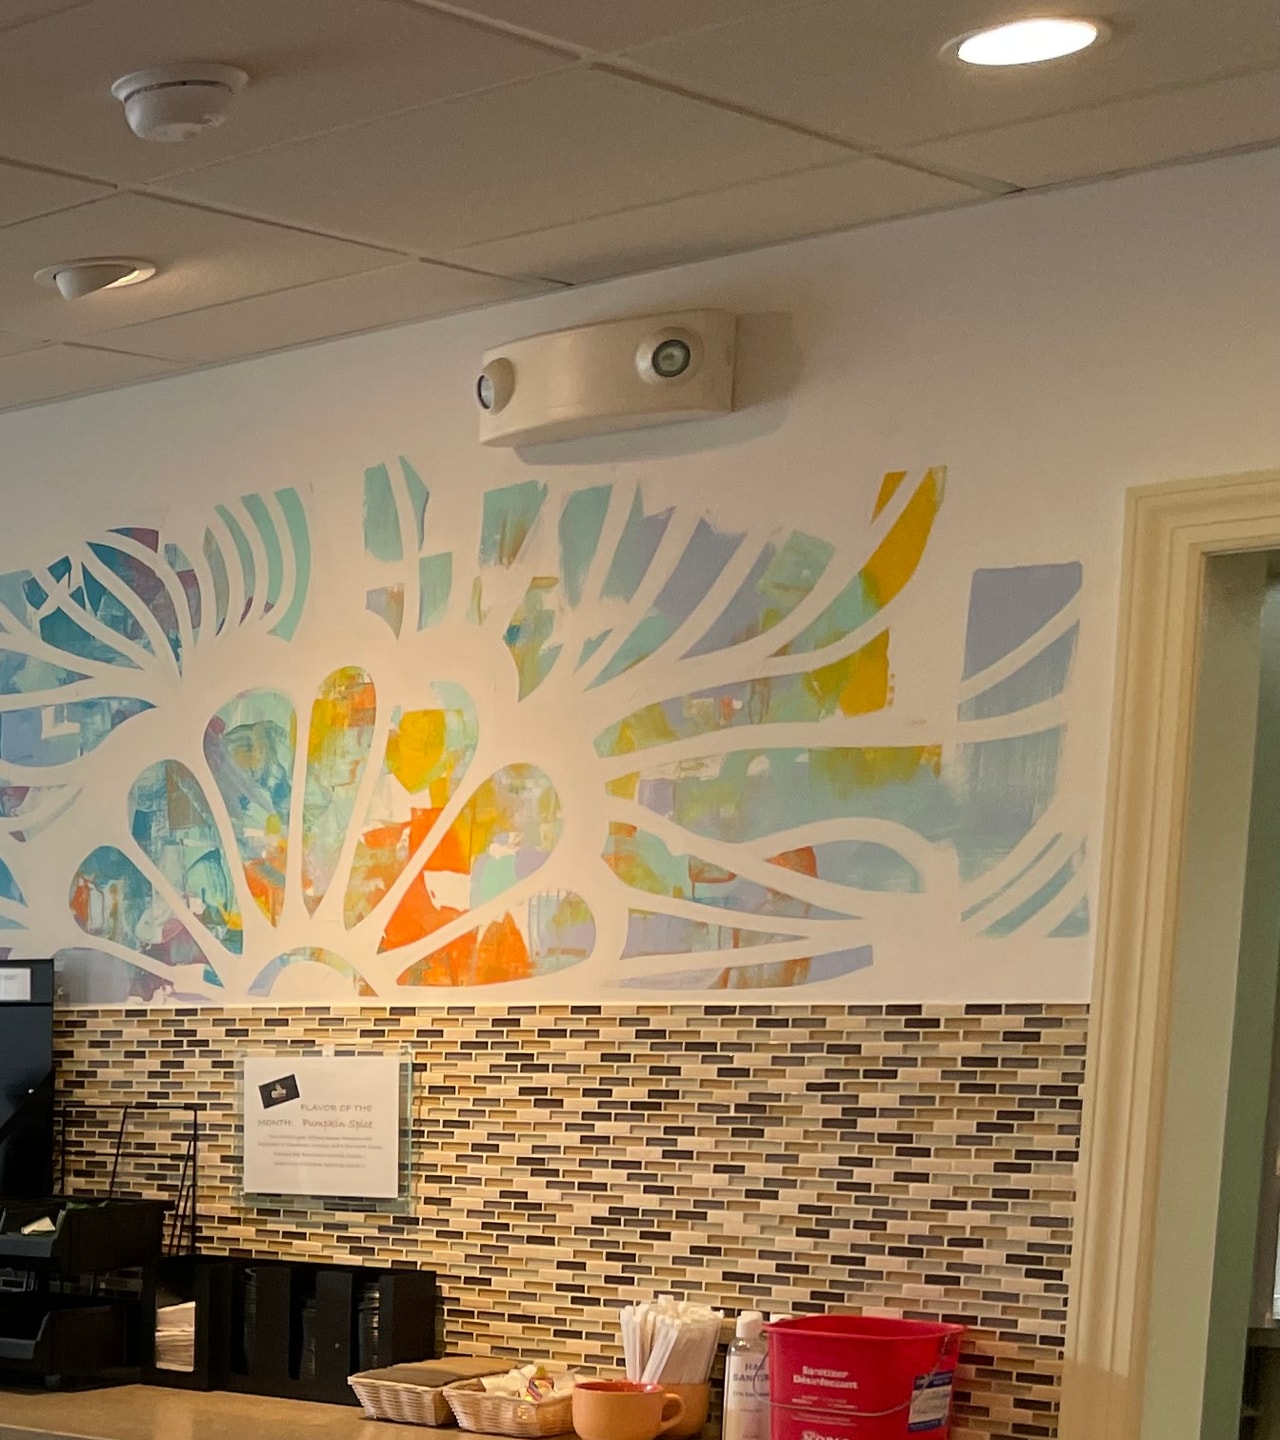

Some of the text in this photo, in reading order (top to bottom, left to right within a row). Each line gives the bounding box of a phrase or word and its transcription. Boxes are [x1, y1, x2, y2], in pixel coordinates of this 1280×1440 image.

[300, 1103, 373, 1113] FLAVOR OF THE
[302, 1118, 346, 1131] Pumpkin
[347, 1118, 374, 1131] Spice
